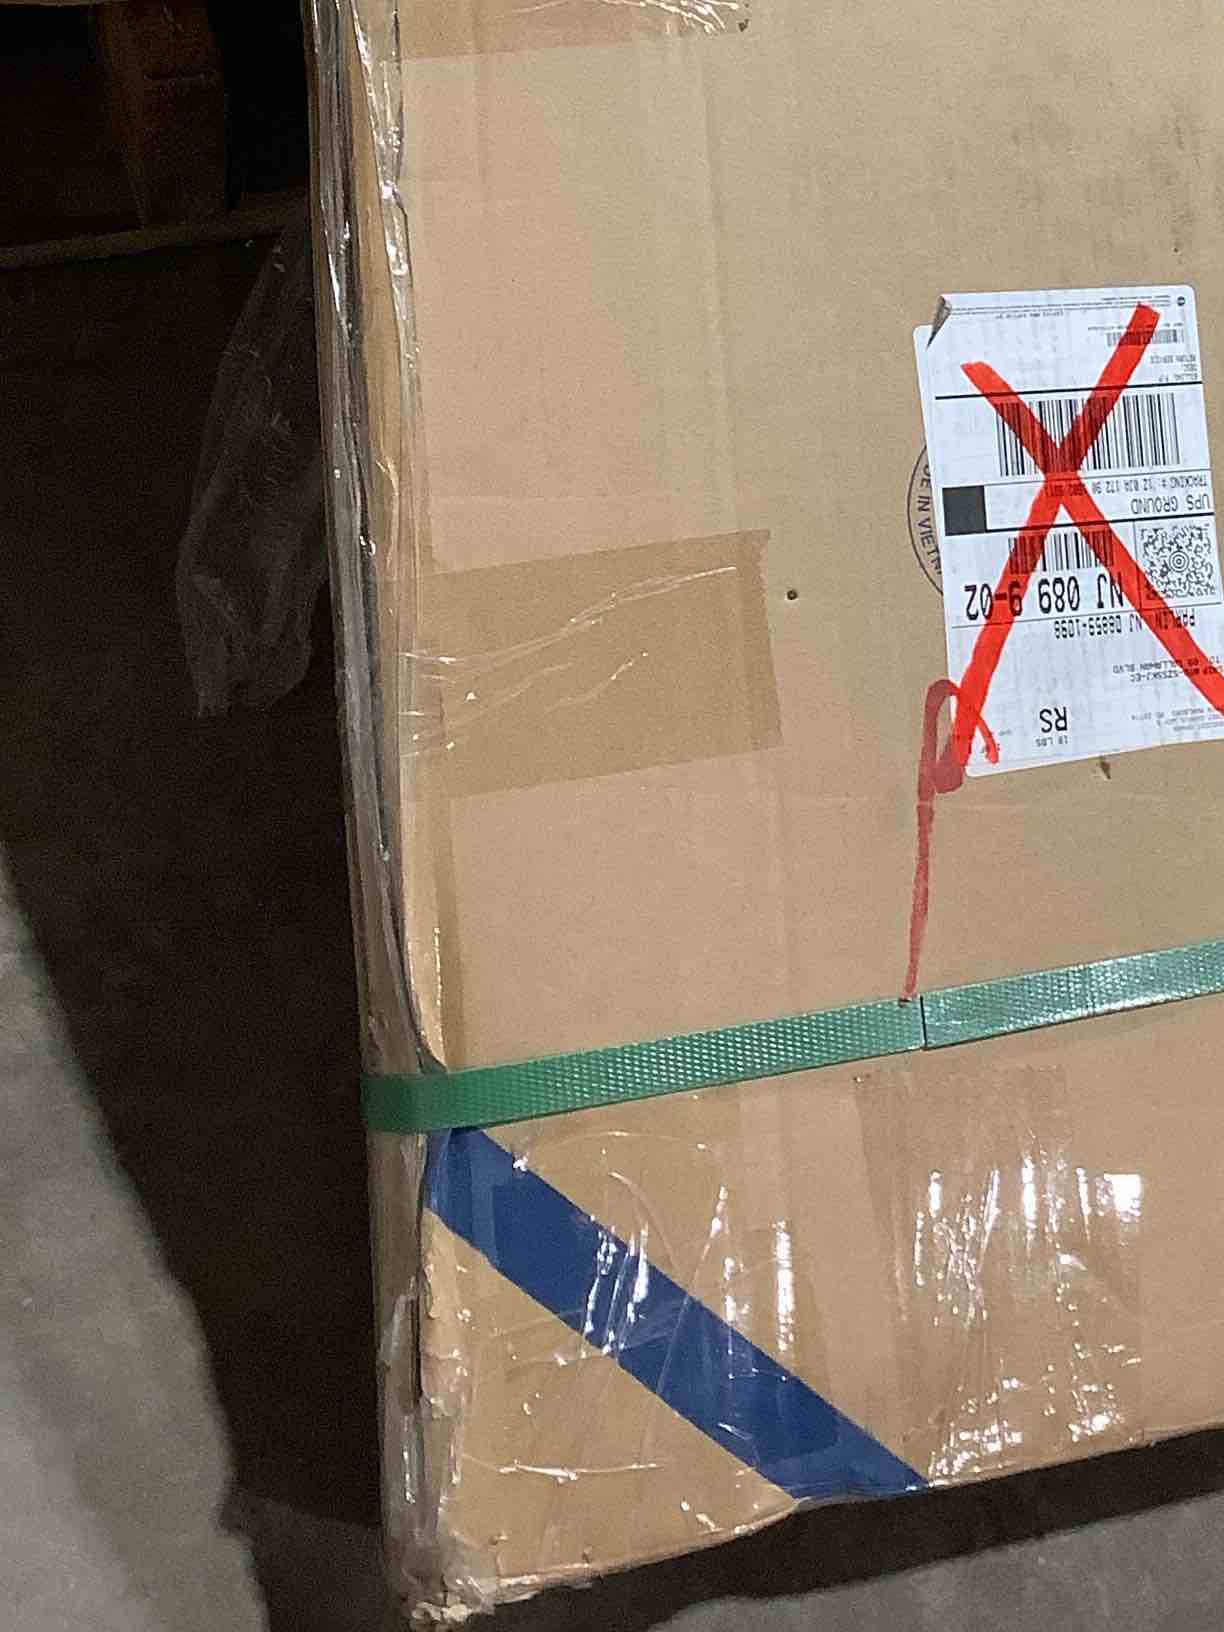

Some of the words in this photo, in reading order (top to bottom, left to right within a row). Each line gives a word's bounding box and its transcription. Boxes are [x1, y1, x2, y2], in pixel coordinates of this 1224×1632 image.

[1130, 496, 1178, 515] GROUND
[1186, 493, 1211, 512] UPS
[963, 580, 1023, 621] 9-02
[1037, 576, 1081, 614] 089
[1096, 571, 1124, 609] NJ
[1039, 707, 1068, 734] RS
